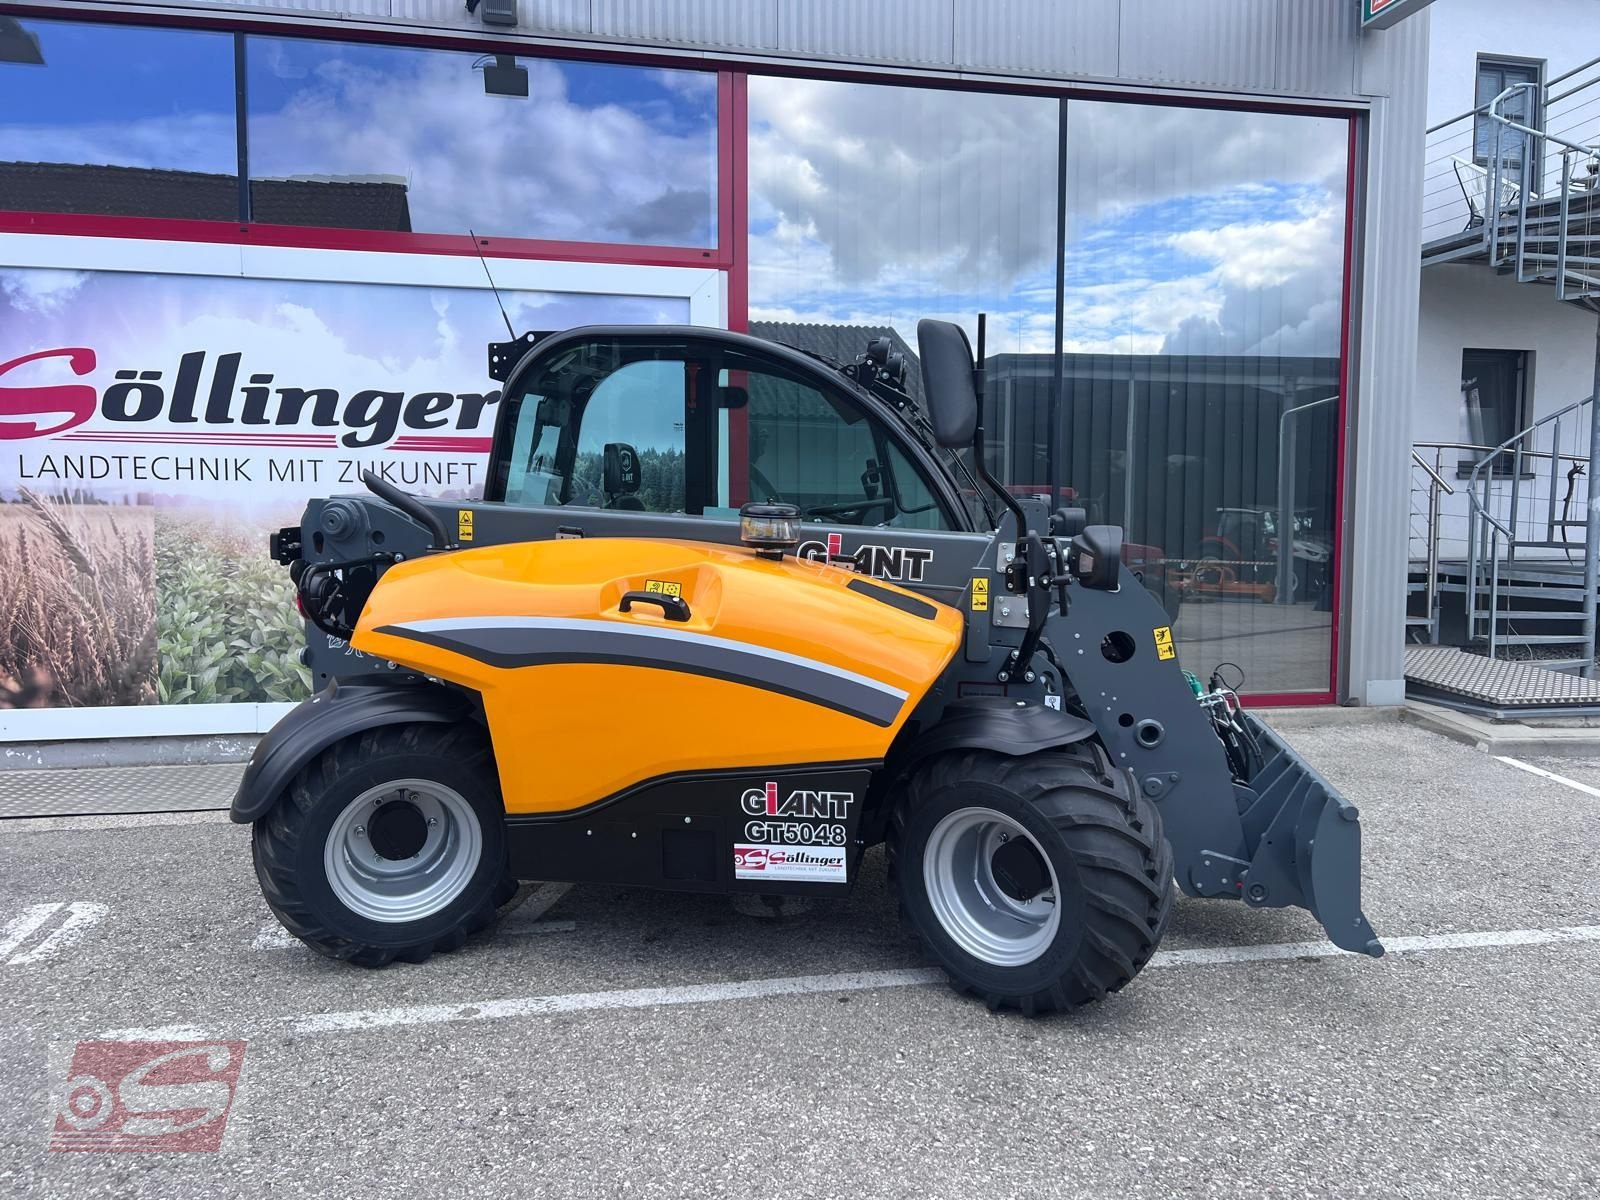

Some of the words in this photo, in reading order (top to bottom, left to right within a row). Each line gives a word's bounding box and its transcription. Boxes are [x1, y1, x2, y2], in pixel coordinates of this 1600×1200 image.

[0, 347, 502, 448] Söllinger
[19, 454, 252, 481] LANDTECHNIK
[269, 459, 323, 482] MIT
[338, 460, 477, 484] ZUKUNFT
[745, 821, 846, 846] GT5048
[769, 851, 843, 867] Söllinger
